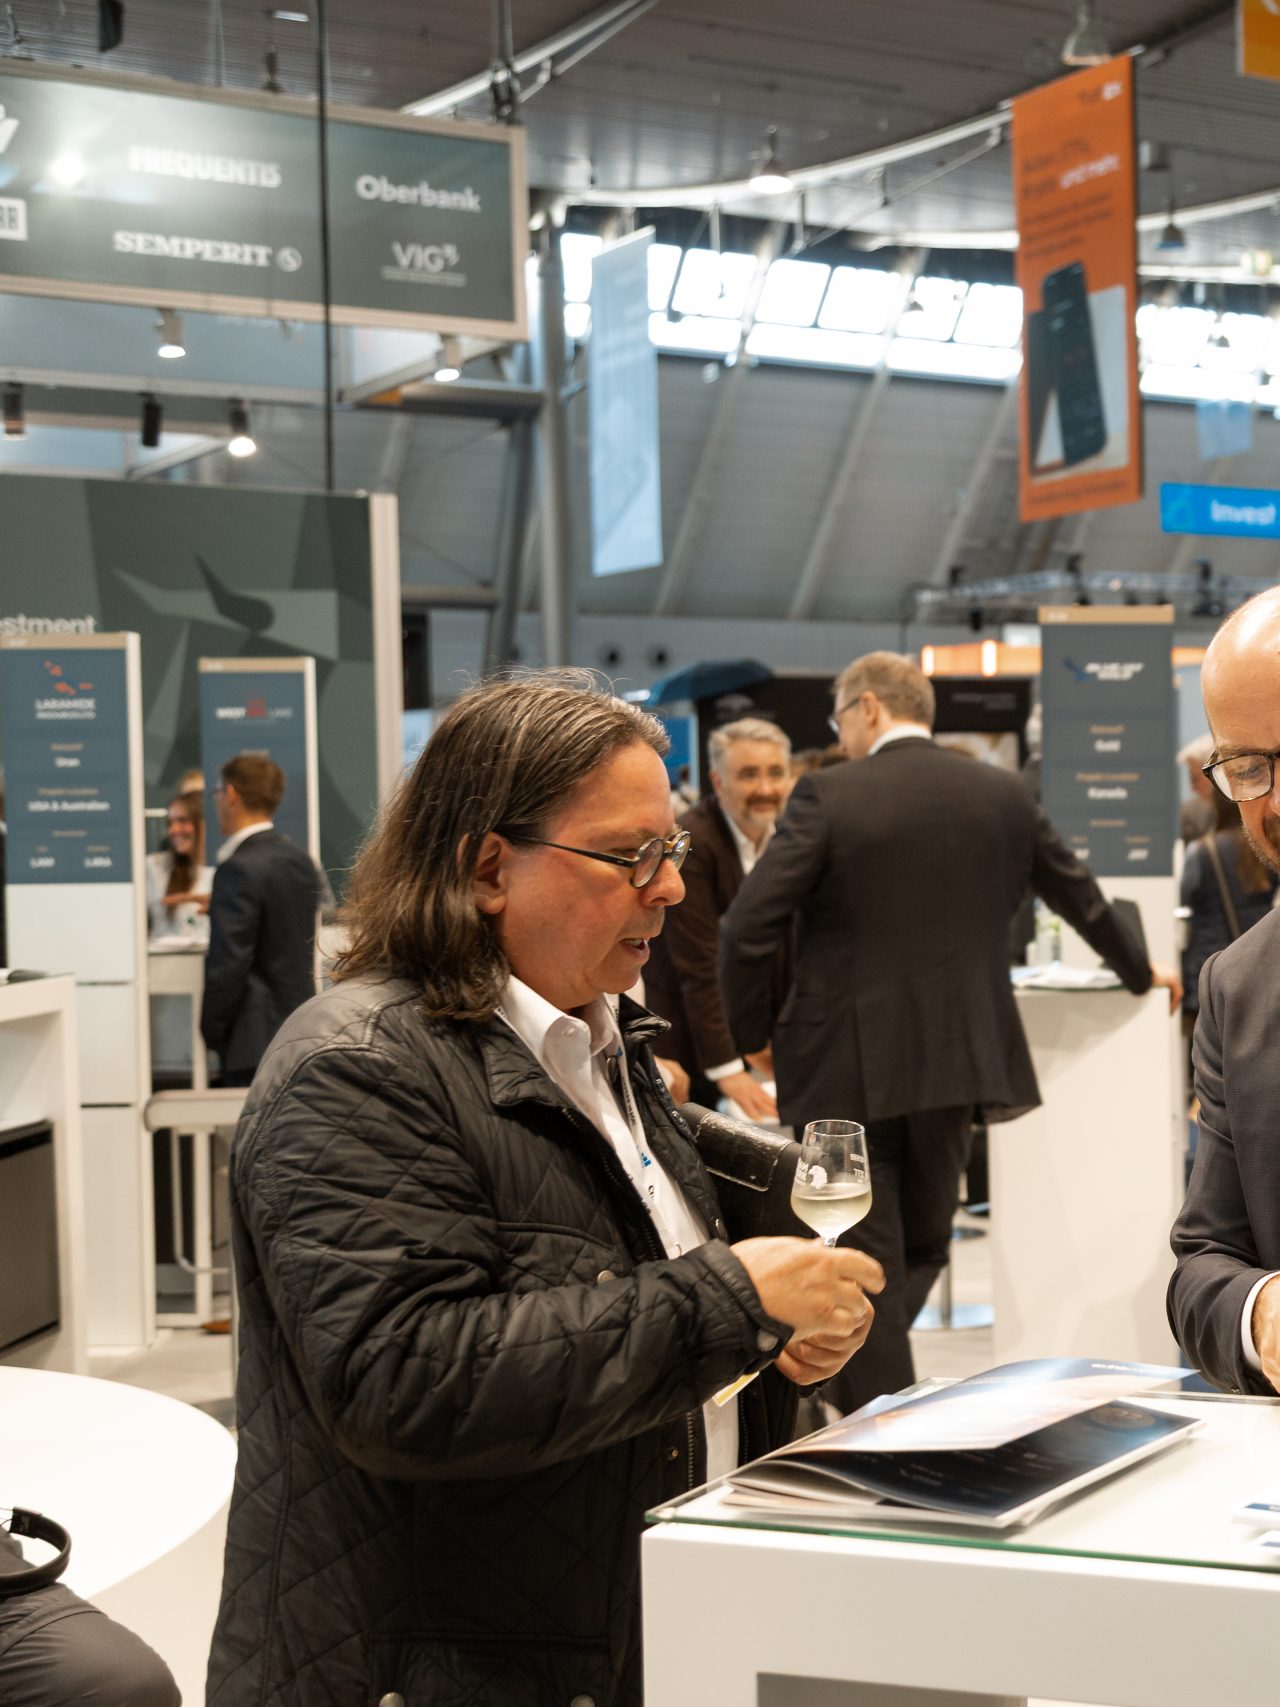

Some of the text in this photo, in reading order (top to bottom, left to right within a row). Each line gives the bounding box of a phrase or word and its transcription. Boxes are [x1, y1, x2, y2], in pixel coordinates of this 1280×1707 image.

[128, 145, 282, 189] FREQUENTIS
[355, 174, 481, 213] Oberbank
[112, 230, 273, 267] SEMPERIT
[391, 240, 445, 273] VIG
[1210, 499, 1276, 526] Invest
[0, 613, 96, 634] stment
